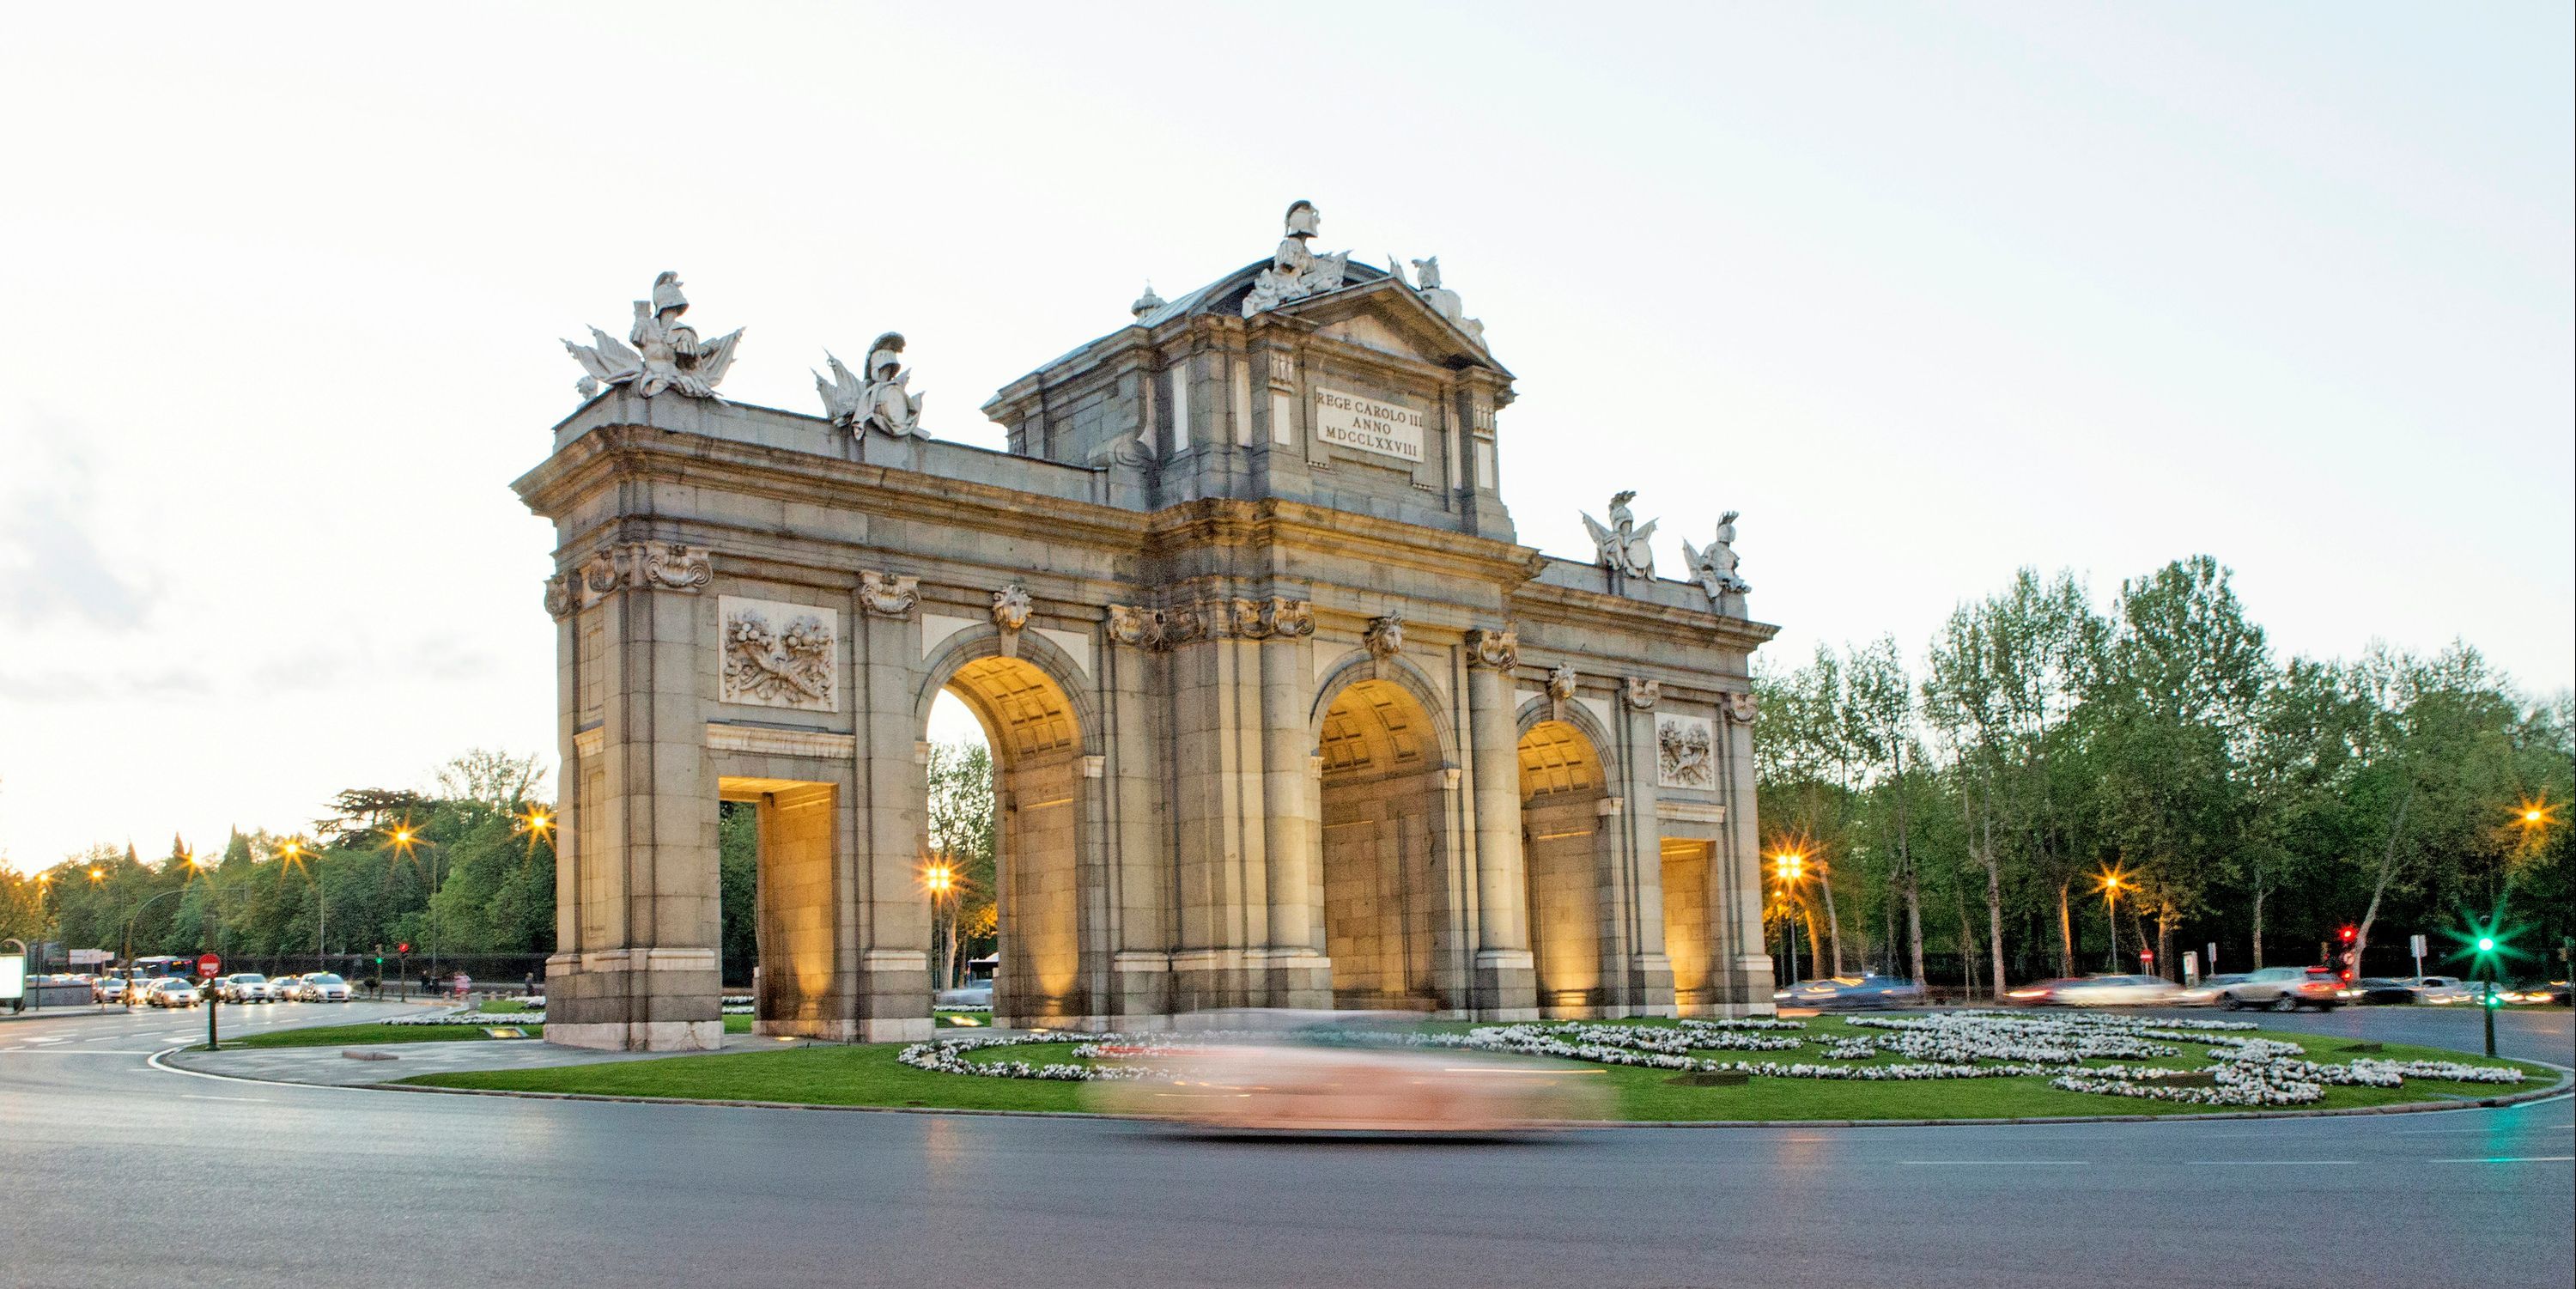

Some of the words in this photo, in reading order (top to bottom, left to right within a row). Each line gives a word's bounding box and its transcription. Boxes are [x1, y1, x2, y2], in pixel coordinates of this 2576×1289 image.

[1317, 392, 1352, 410] REGE
[1355, 401, 1406, 423] CAROLO
[1410, 414, 1423, 428] III
[1352, 416, 1391, 435] ANNO
[1326, 425, 1417, 457] MDCCLXXVIII
